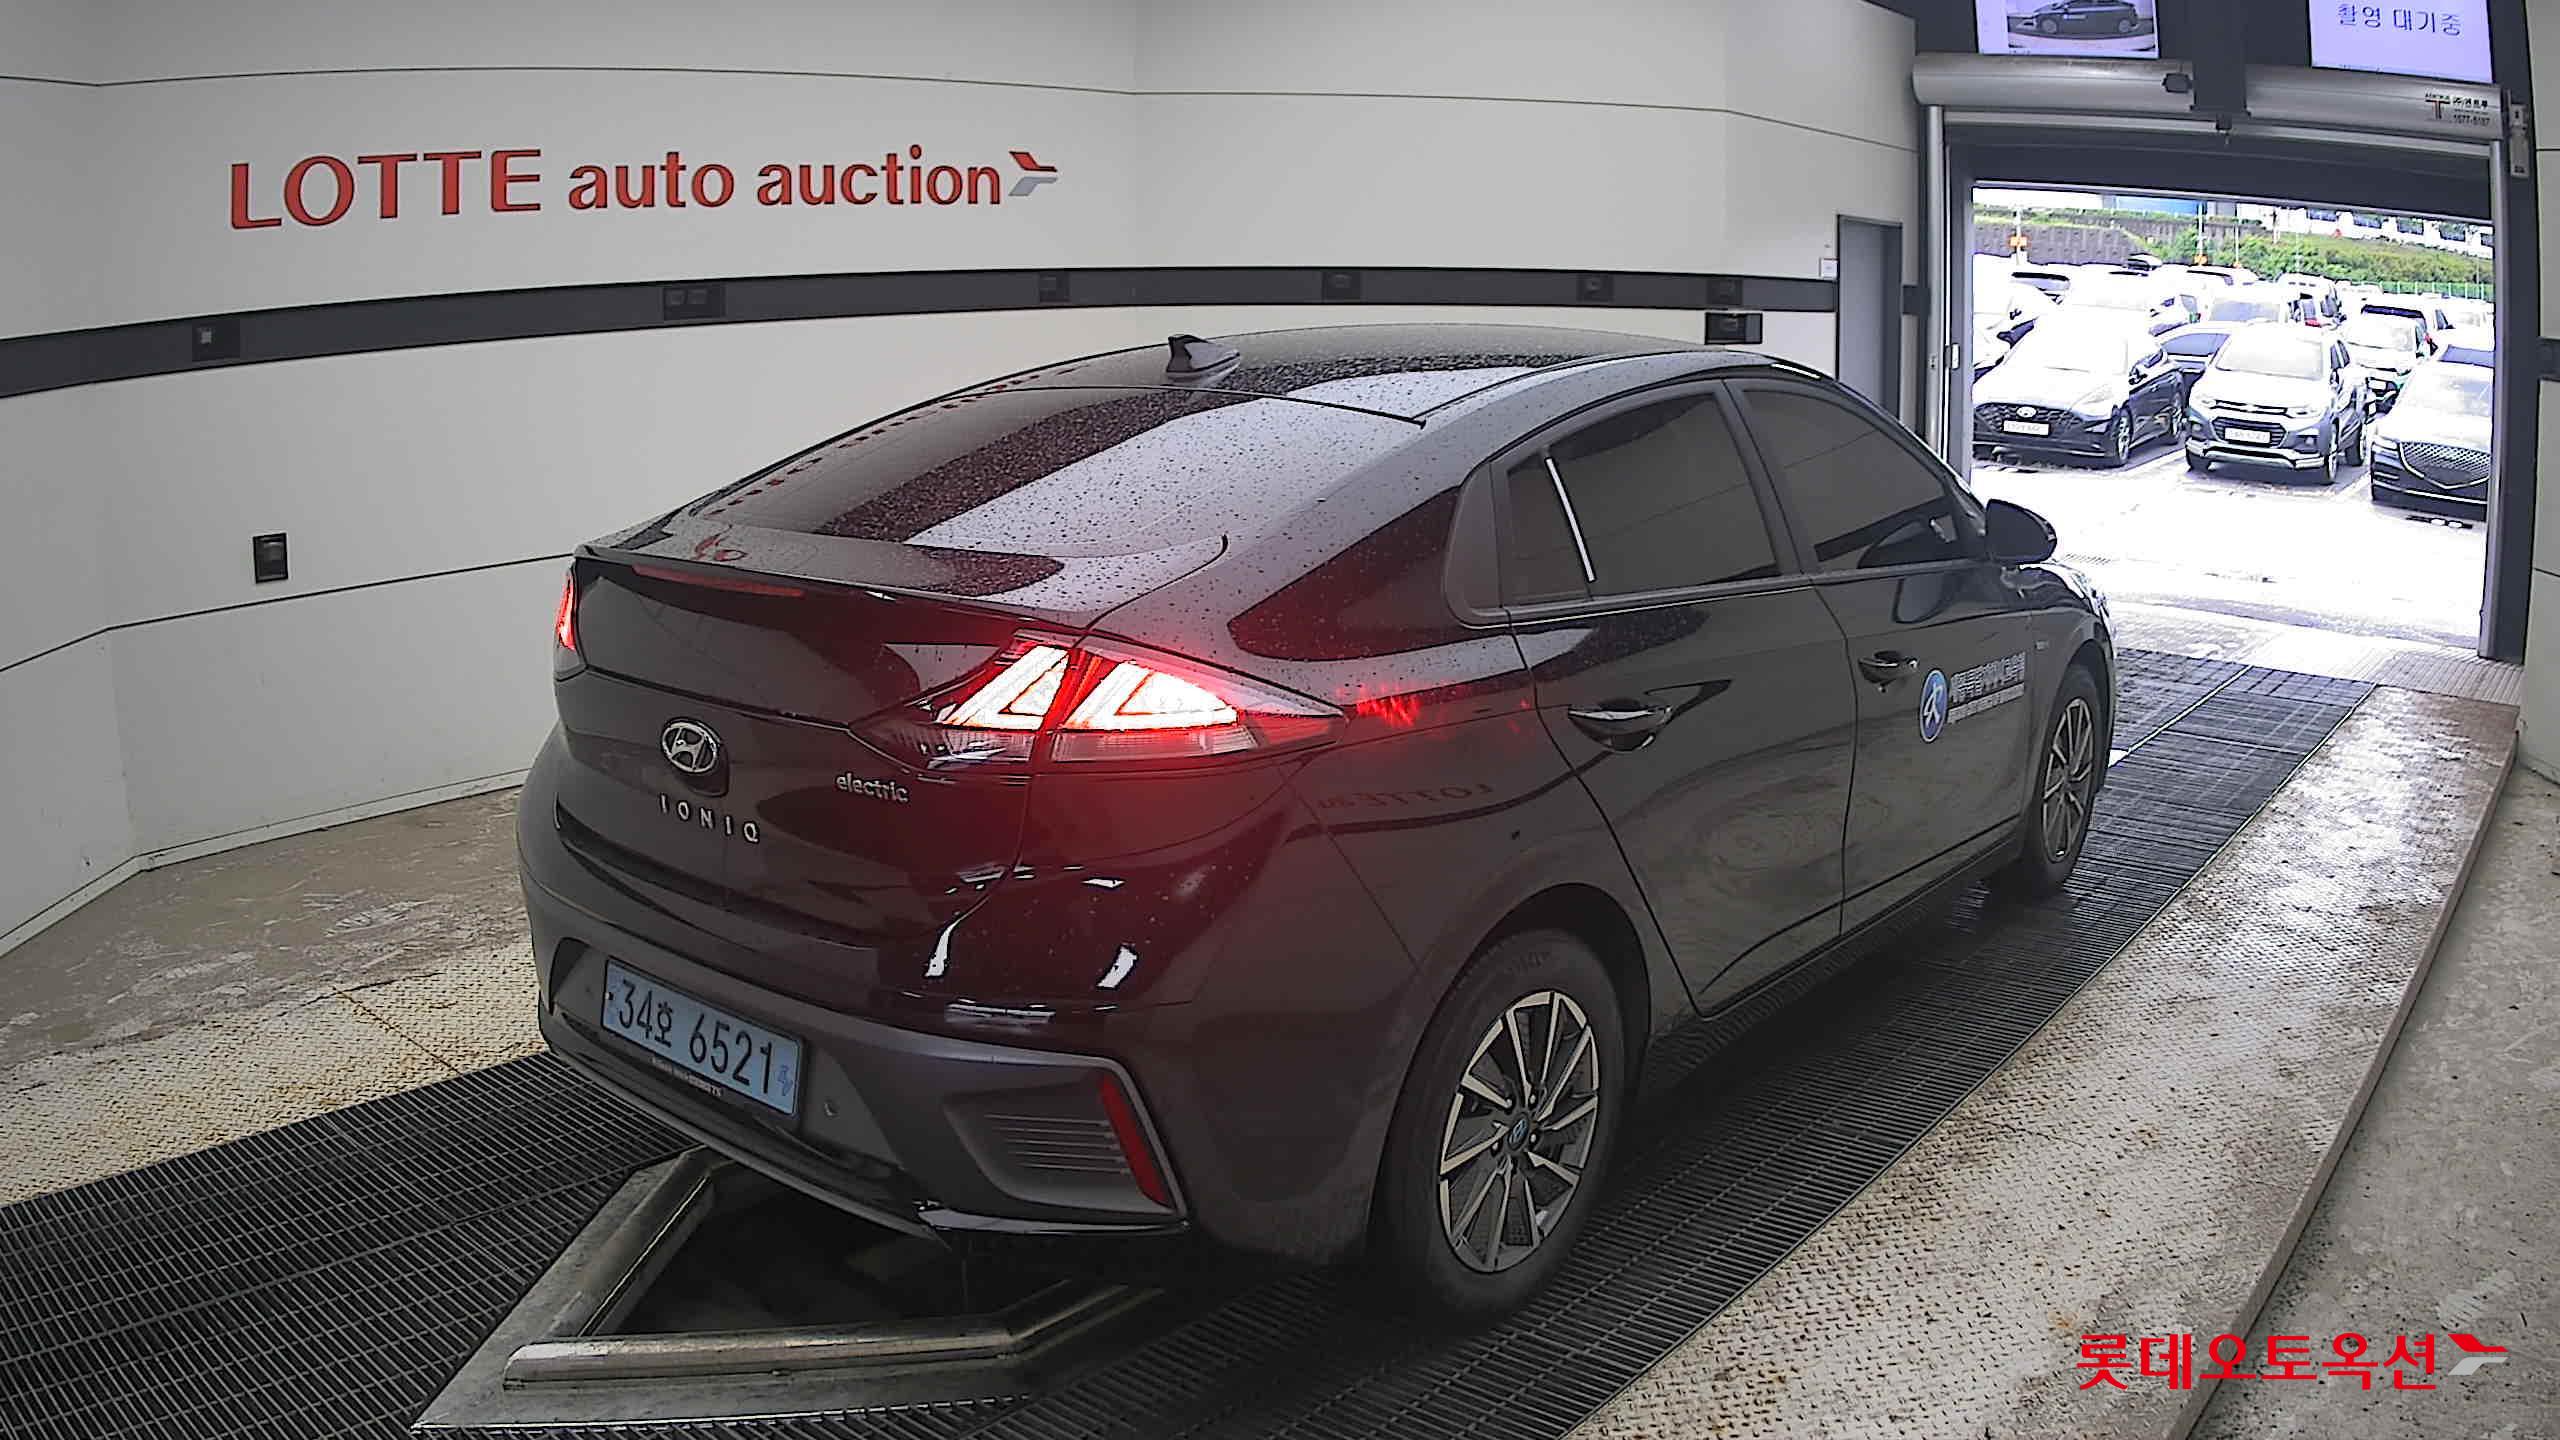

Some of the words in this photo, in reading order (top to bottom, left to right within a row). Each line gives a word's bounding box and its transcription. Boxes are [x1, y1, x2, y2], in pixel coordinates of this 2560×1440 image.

[2338, 4, 2381, 28] 촬영
[2393, 9, 2461, 36] 대기중
[231, 149, 541, 230] LOTTE
[568, 150, 735, 209] auto
[757, 145, 1002, 206] auction
[836, 772, 908, 803] electric
[660, 794, 759, 843] IONIQ
[619, 978, 673, 1048] 34호
[689, 1013, 773, 1094] 6521
